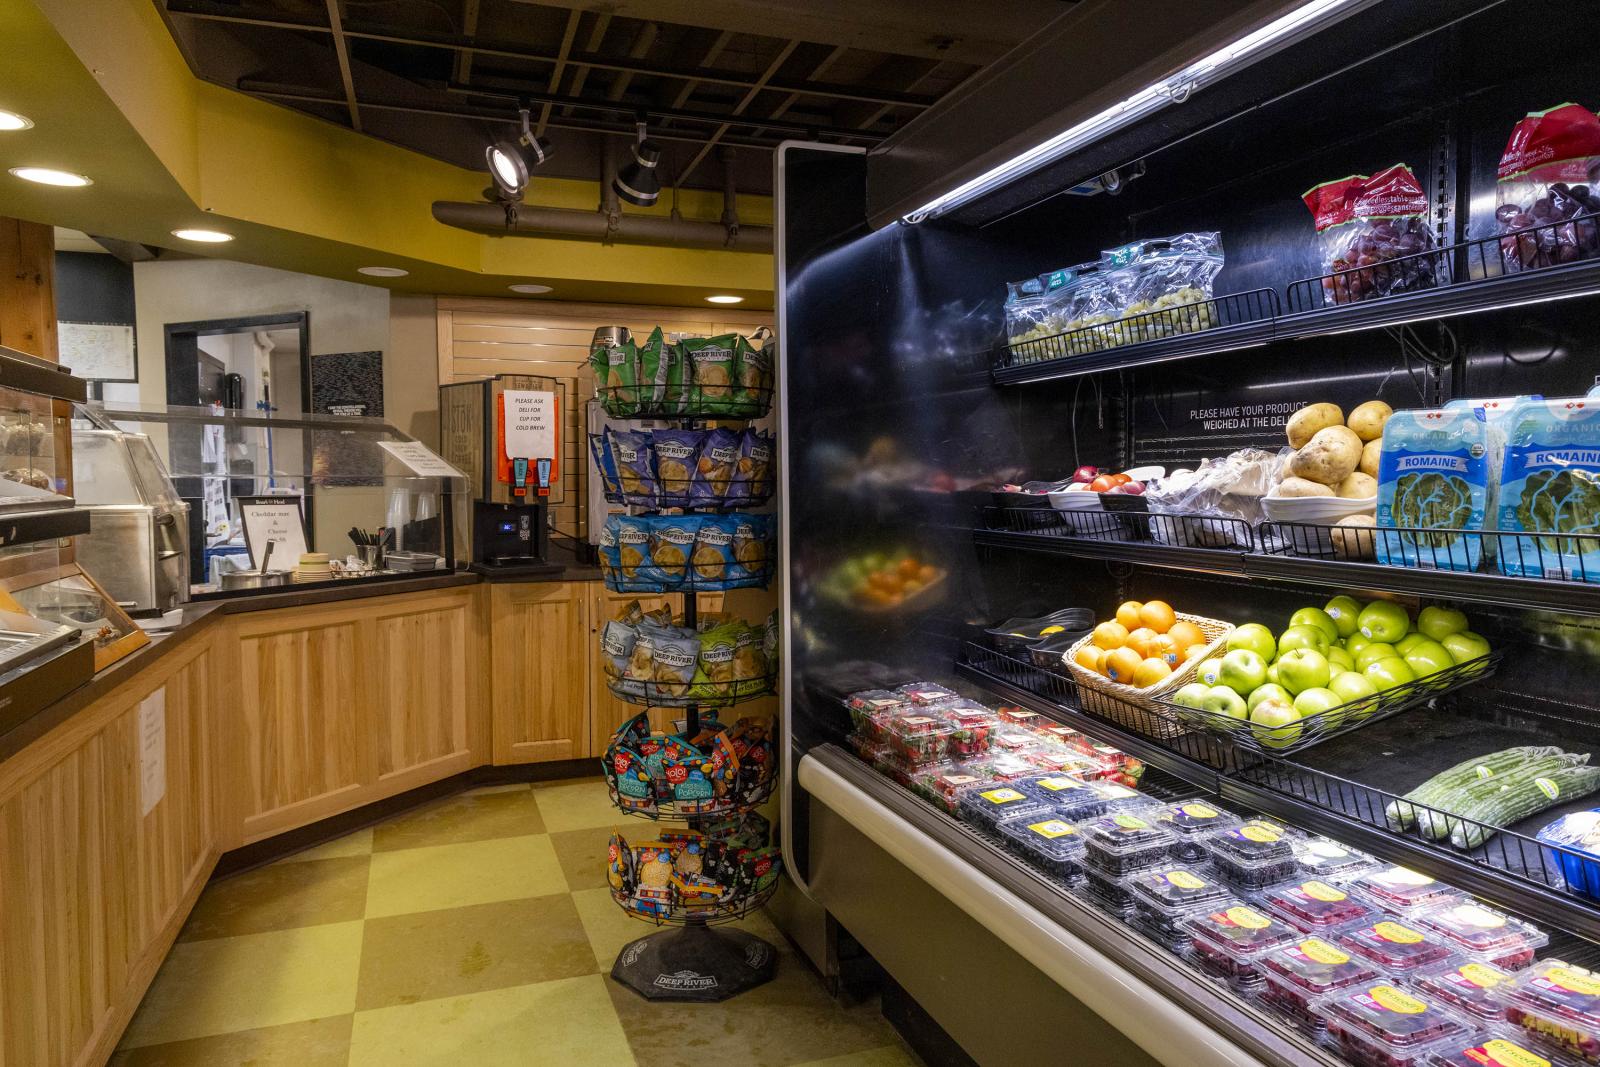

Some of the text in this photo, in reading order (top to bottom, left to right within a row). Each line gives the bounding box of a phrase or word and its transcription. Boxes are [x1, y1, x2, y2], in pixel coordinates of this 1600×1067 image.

[1190, 402, 1308, 420] PLEASE HAVE YOUR PRODUCE
[1240, 418, 1250, 428] AT
[1252, 416, 1268, 428] THE
[672, 448, 692, 456] RIVER
[1406, 458, 1457, 468] ROMAINE
[712, 534, 732, 542] RIVER
[654, 652, 693, 664] DEEP RIVER
[658, 976, 683, 986] DEEP
